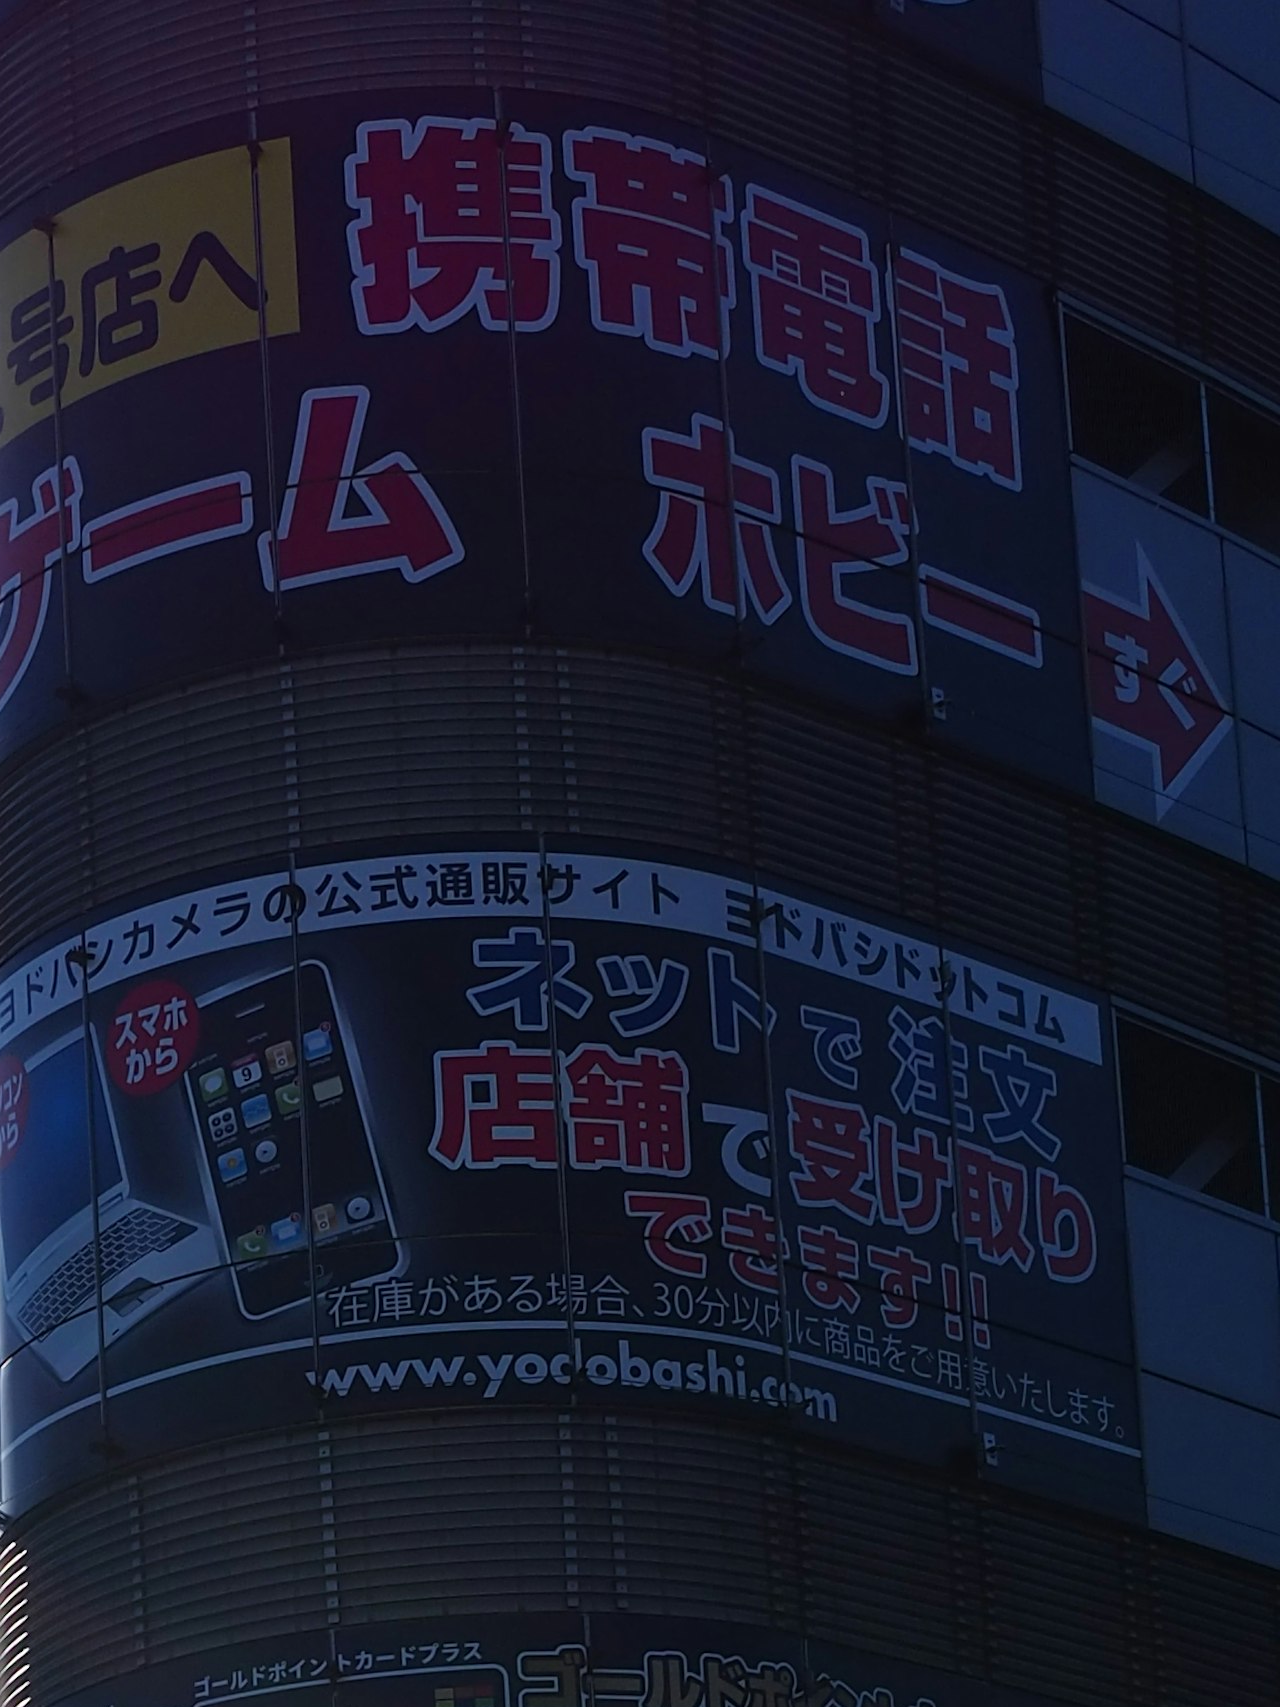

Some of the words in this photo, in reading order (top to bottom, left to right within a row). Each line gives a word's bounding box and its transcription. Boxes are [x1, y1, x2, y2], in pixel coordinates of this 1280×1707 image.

[343, 114, 1023, 492] 携帯電話
[641, 412, 1044, 678] ホビー
[1103, 632, 1200, 732] すぐ
[114, 995, 190, 1051] スマホ
[123, 1048, 181, 1086] から
[466, 925, 1063, 1163] ネットで注文
[426, 1037, 1098, 1285] 店舗で受け取り
[306, 1338, 840, 1424] www.yodobashi.com
